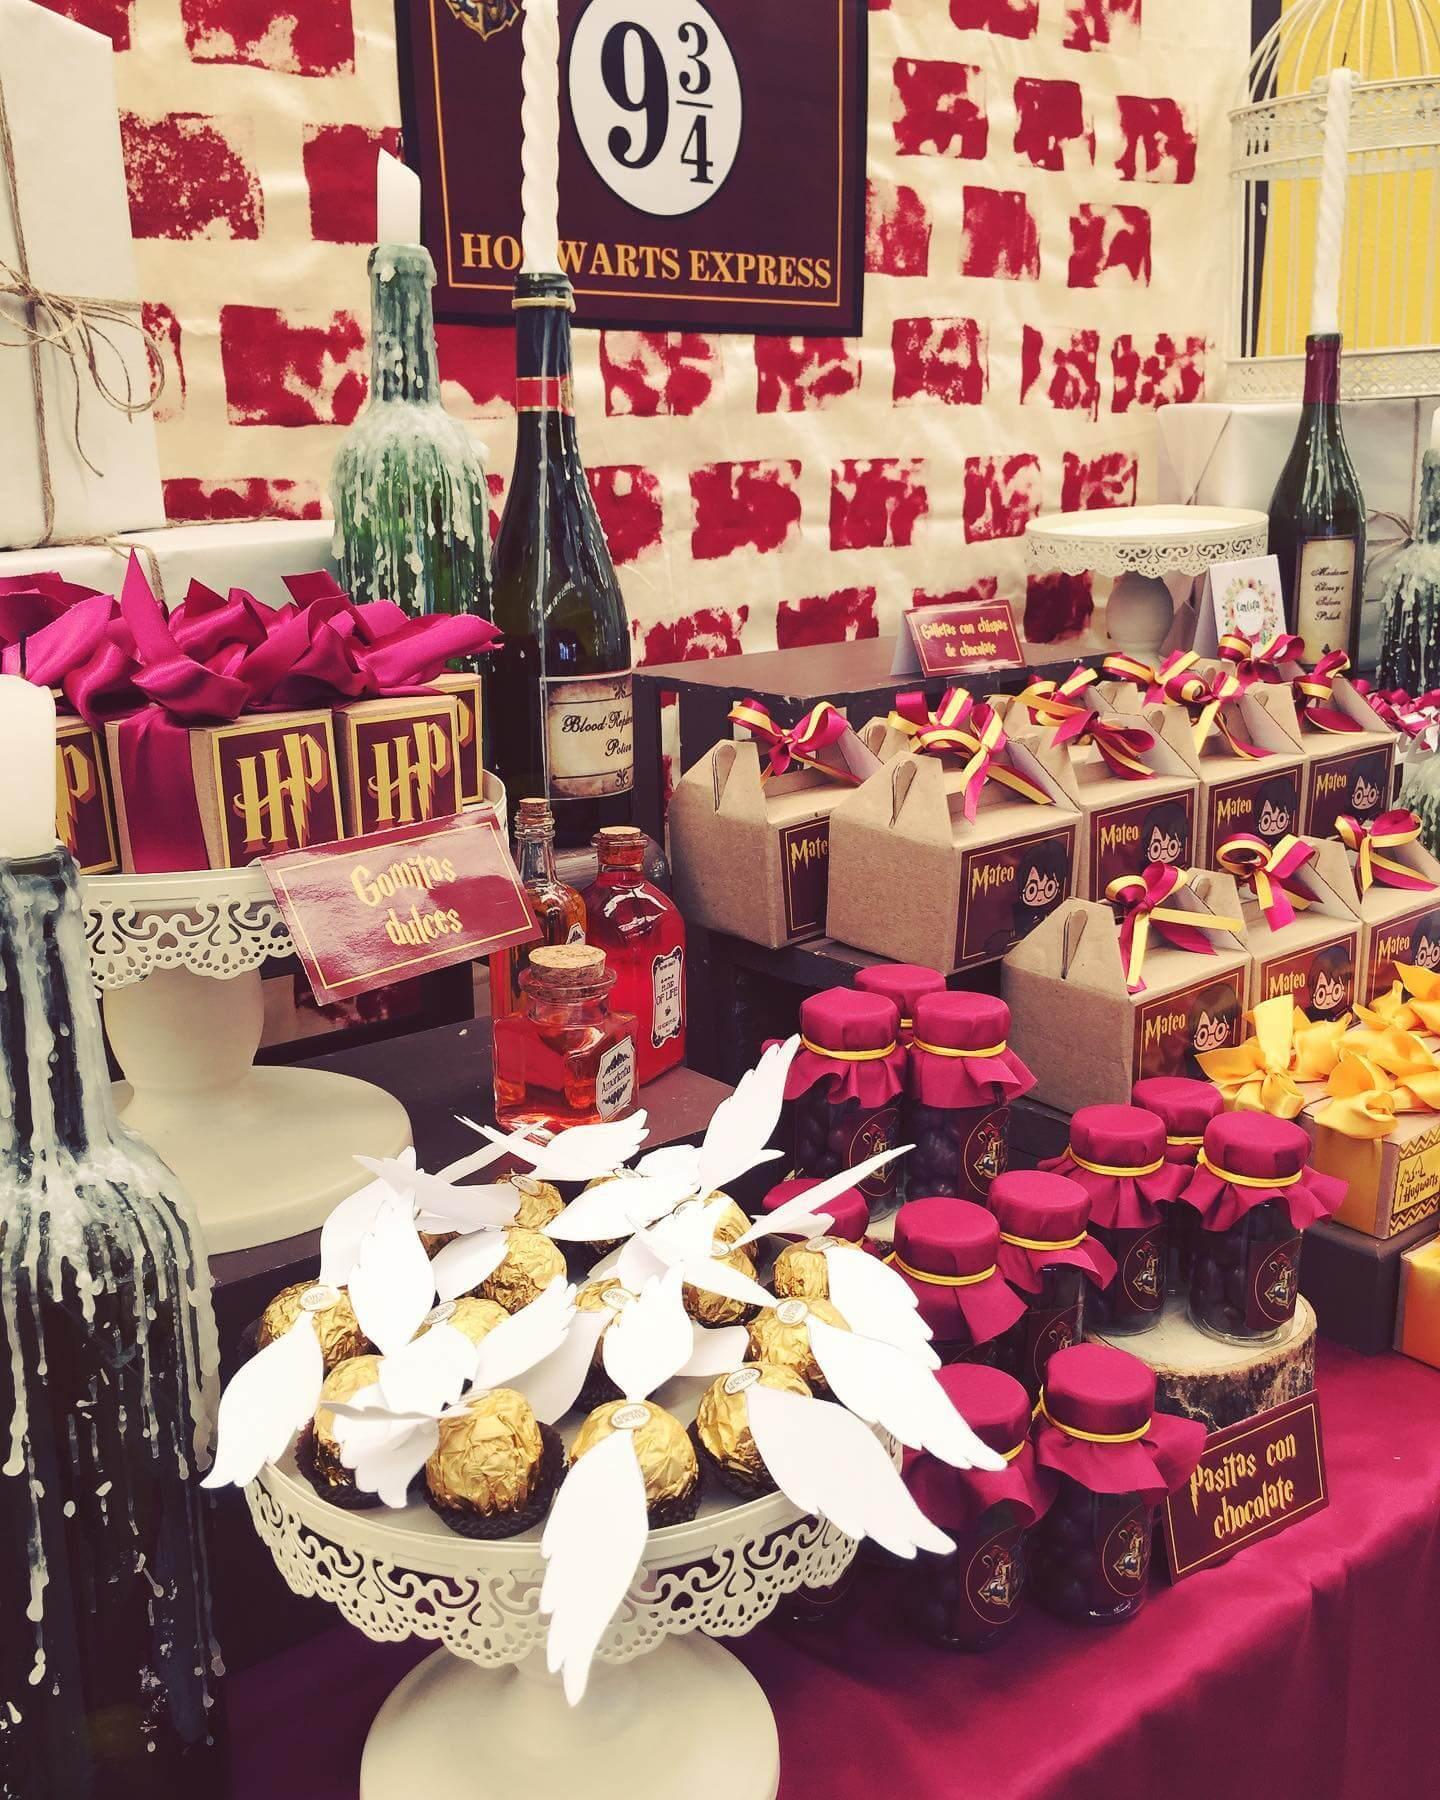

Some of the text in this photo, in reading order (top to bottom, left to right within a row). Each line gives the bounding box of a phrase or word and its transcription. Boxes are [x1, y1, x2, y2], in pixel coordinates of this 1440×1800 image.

[461, 232, 832, 289] HOWARTS EXPRESS
[920, 623, 956, 640] Galletas
[960, 623, 975, 634] con
[945, 641, 996, 657] de chocolate
[367, 722, 453, 823] HP
[1316, 772, 1347, 799] Mateo
[233, 733, 328, 853] HP
[1217, 797, 1251, 827] Mateo
[791, 838, 830, 873] Mate
[1100, 824, 1139, 857] Mateo
[351, 855, 457, 908] Gomitas
[972, 864, 1015, 899] Mateo
[386, 905, 463, 947] dulces
[1379, 934, 1410, 967] Mateo
[665, 986, 678, 1001] LIFE
[1269, 970, 1305, 999] Mateo
[1144, 1009, 1186, 1050] Mateo
[1404, 1173, 1438, 1203] Hogwarts
[1190, 1433, 1296, 1516] Pasitas con
[1213, 1476, 1295, 1539] chocolate
